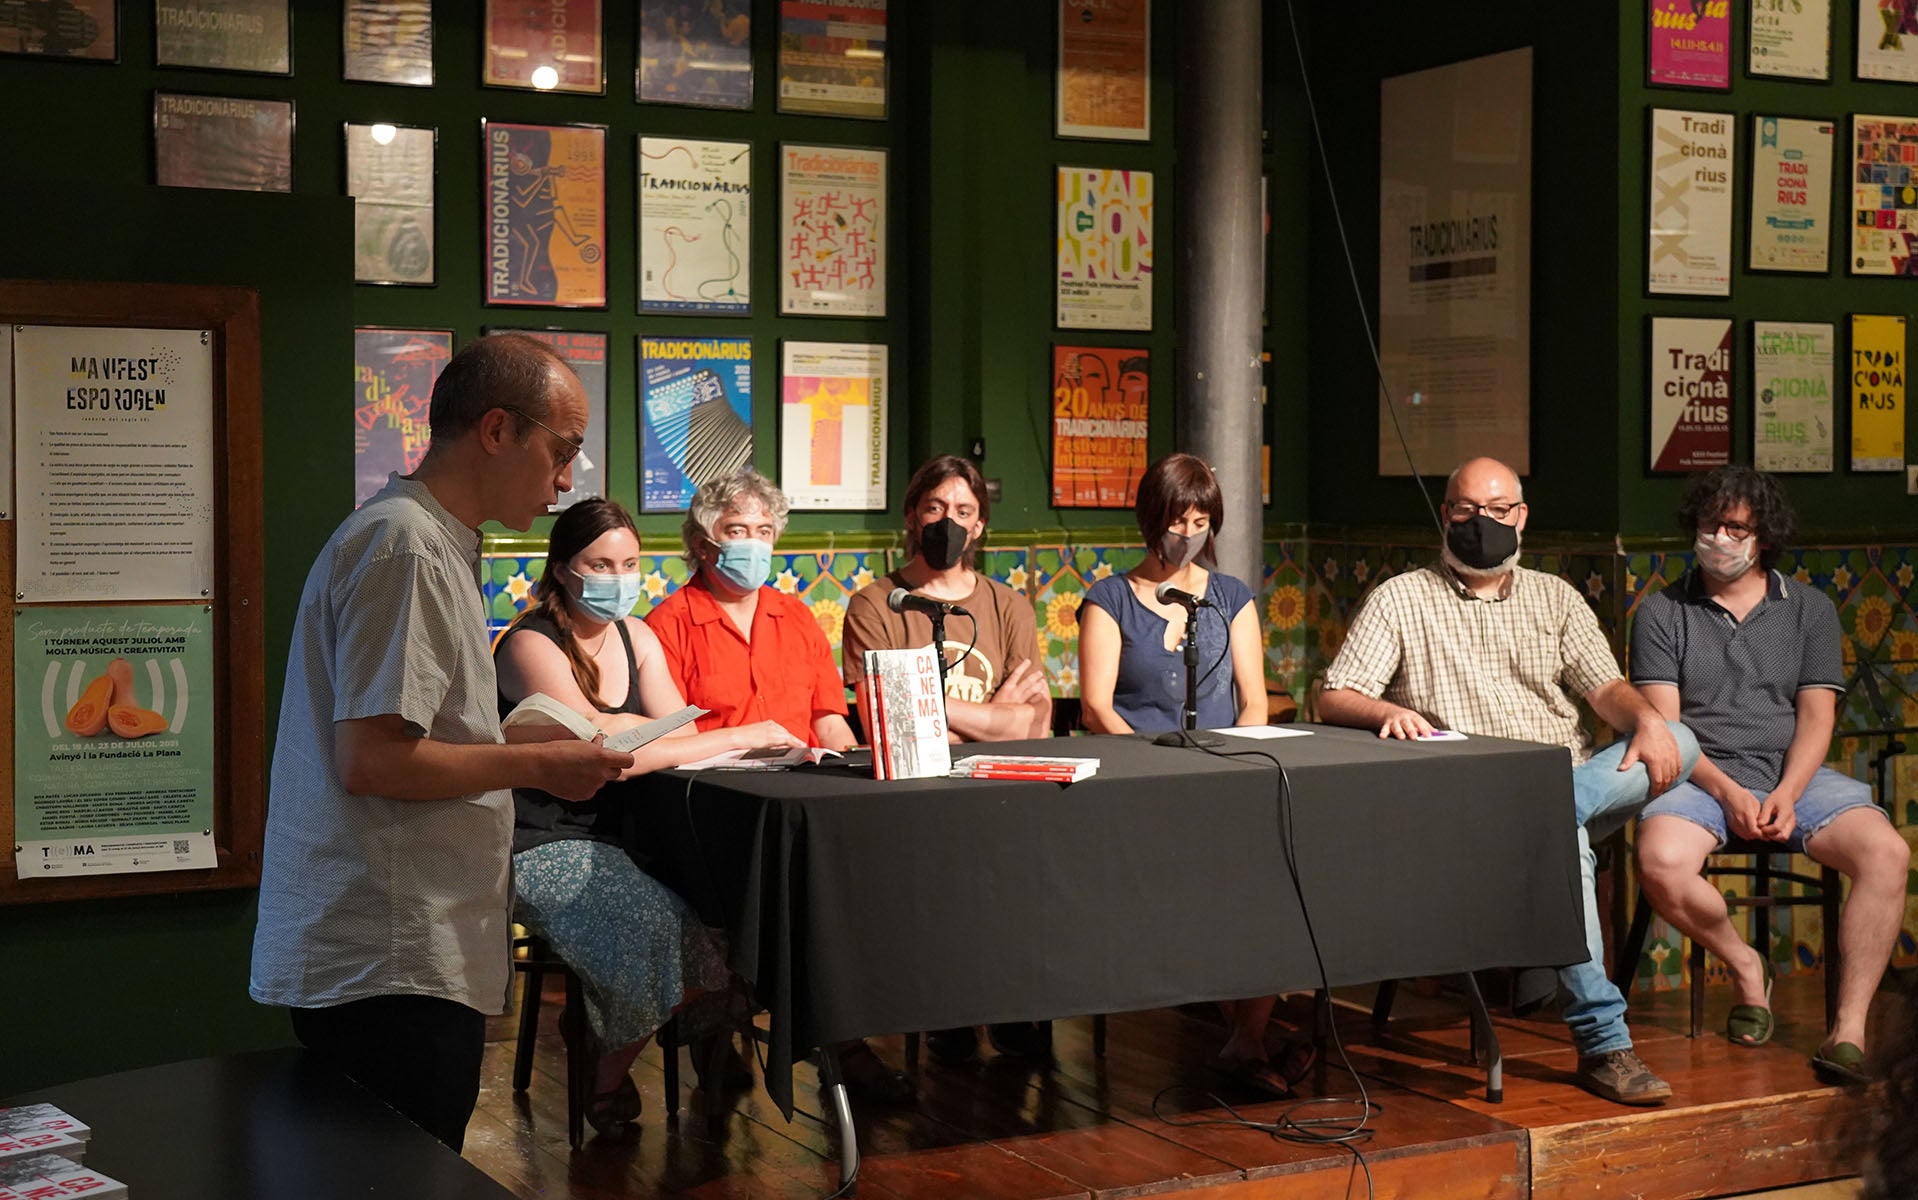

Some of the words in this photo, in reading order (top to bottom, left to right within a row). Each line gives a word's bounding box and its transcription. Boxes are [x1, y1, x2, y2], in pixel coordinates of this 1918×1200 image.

[1681, 117, 1725, 136] Tradi
[1680, 142, 1728, 161] cionà
[1695, 167, 1728, 184] rius
[1778, 162, 1808, 175] TRADI
[1777, 190, 1807, 206] RIUS
[1668, 348, 1729, 371] Tradi
[1854, 350, 1899, 368] TRADI
[71, 357, 159, 381] MANIFEST
[1664, 376, 1729, 399] cionà
[67, 387, 166, 411] ESPOROGEN
[1055, 387, 1089, 418] 20
[1683, 400, 1729, 423] rius
[50, 638, 90, 646] TORNEM
[92, 637, 130, 646] AQUEST
[131, 636, 163, 645] JULIOL
[165, 636, 186, 644] AMB
[46, 648, 80, 656] MOLTA
[82, 646, 116, 655] MÚSICA
[916, 655, 934, 674] CA
[920, 677, 937, 696] NE
[918, 698, 939, 718] MA
[933, 718, 943, 738] S
[50, 752, 81, 762] Avinyó
[99, 750, 142, 760] Fundació
[143, 750, 154, 758] La
[156, 748, 181, 758] Plana
[52, 743, 71, 751] DEL
[83, 743, 96, 751] AL
[110, 741, 124, 750] DE
[126, 740, 157, 749] JULIOL
